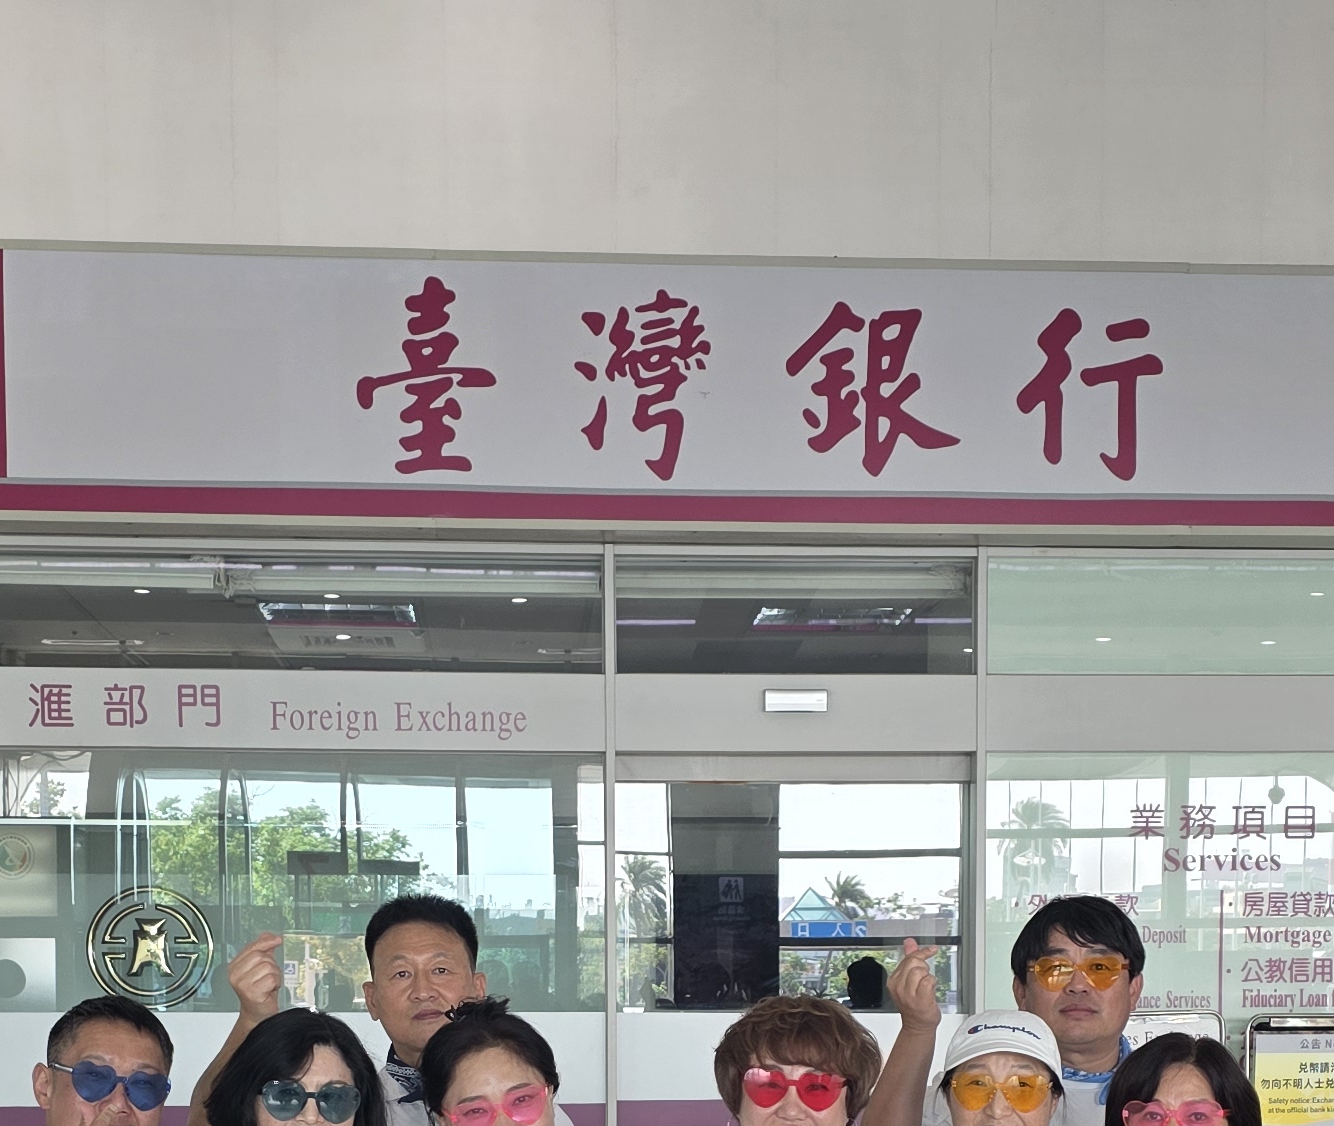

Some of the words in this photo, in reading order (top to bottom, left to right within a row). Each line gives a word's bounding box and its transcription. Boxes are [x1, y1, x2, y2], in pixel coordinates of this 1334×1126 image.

[356, 276, 1164, 481] 臺灣銀行
[269, 698, 379, 742] Foreign
[394, 699, 528, 743] Exchange
[1129, 803, 1317, 840] 業務項目
[1163, 847, 1282, 874] Services
[1142, 925, 1187, 948] Deposit
[1243, 925, 1332, 948] Mortgage
[1166, 990, 1211, 1009] Services
[1242, 988, 1297, 1010] Fiduciary
[1299, 988, 1329, 1008] Loan
[967, 1023, 1041, 1040] Champion
[1300, 1038, 1321, 1050] 公告
[1268, 1097, 1288, 1105] Safety
[1286, 1106, 1309, 1114] official
